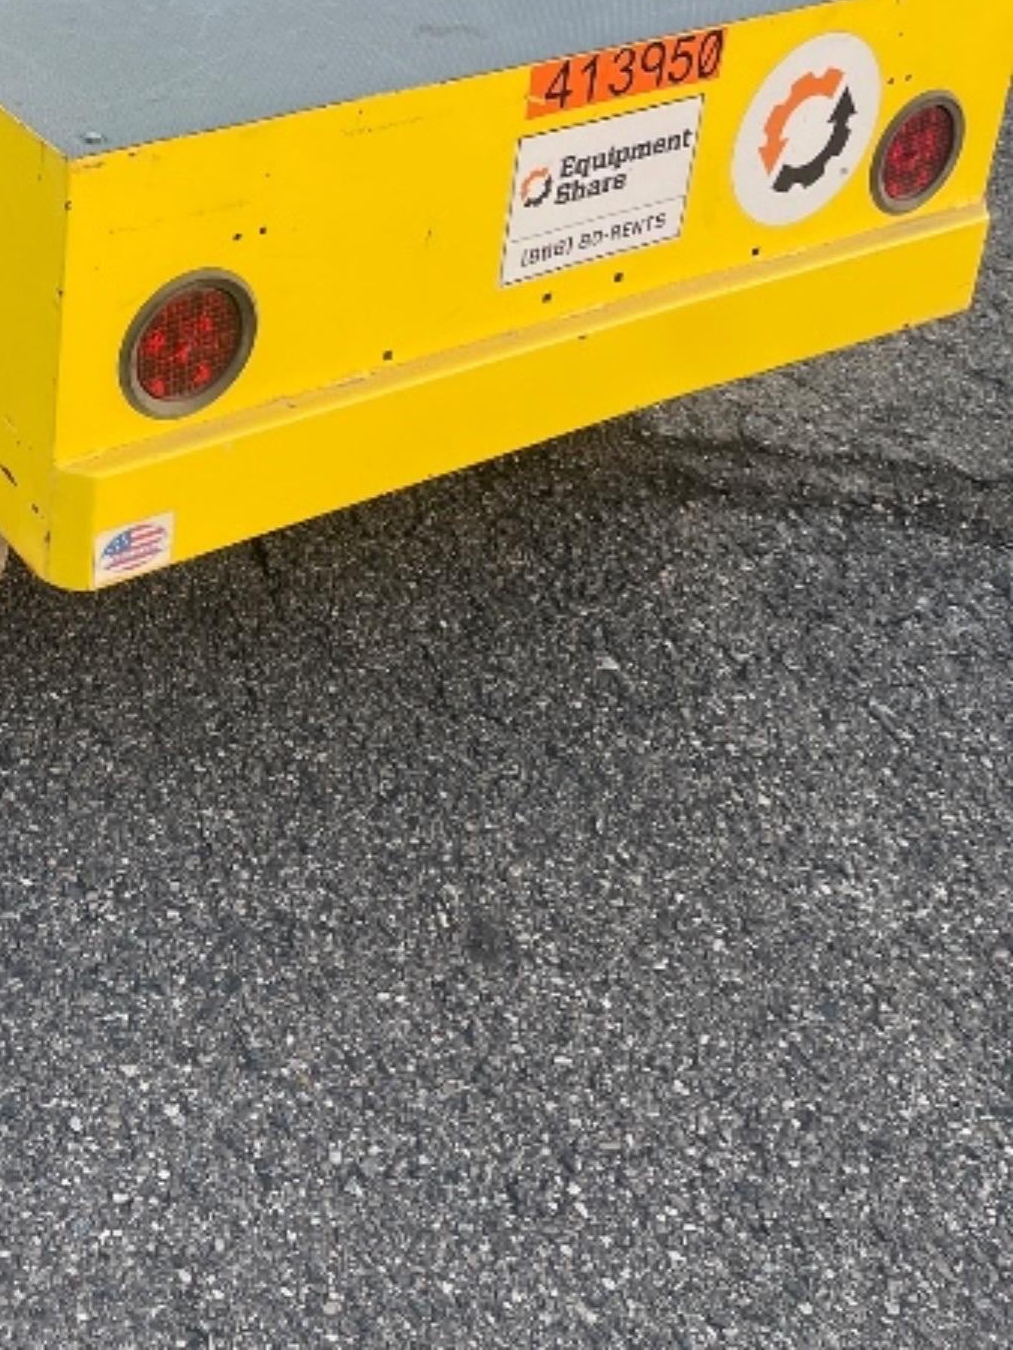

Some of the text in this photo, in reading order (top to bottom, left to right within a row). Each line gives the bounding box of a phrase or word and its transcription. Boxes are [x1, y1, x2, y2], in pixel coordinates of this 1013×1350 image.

[544, 29, 724, 109] 413950
[559, 128, 693, 178] Equipment
[553, 173, 628, 205] Share
